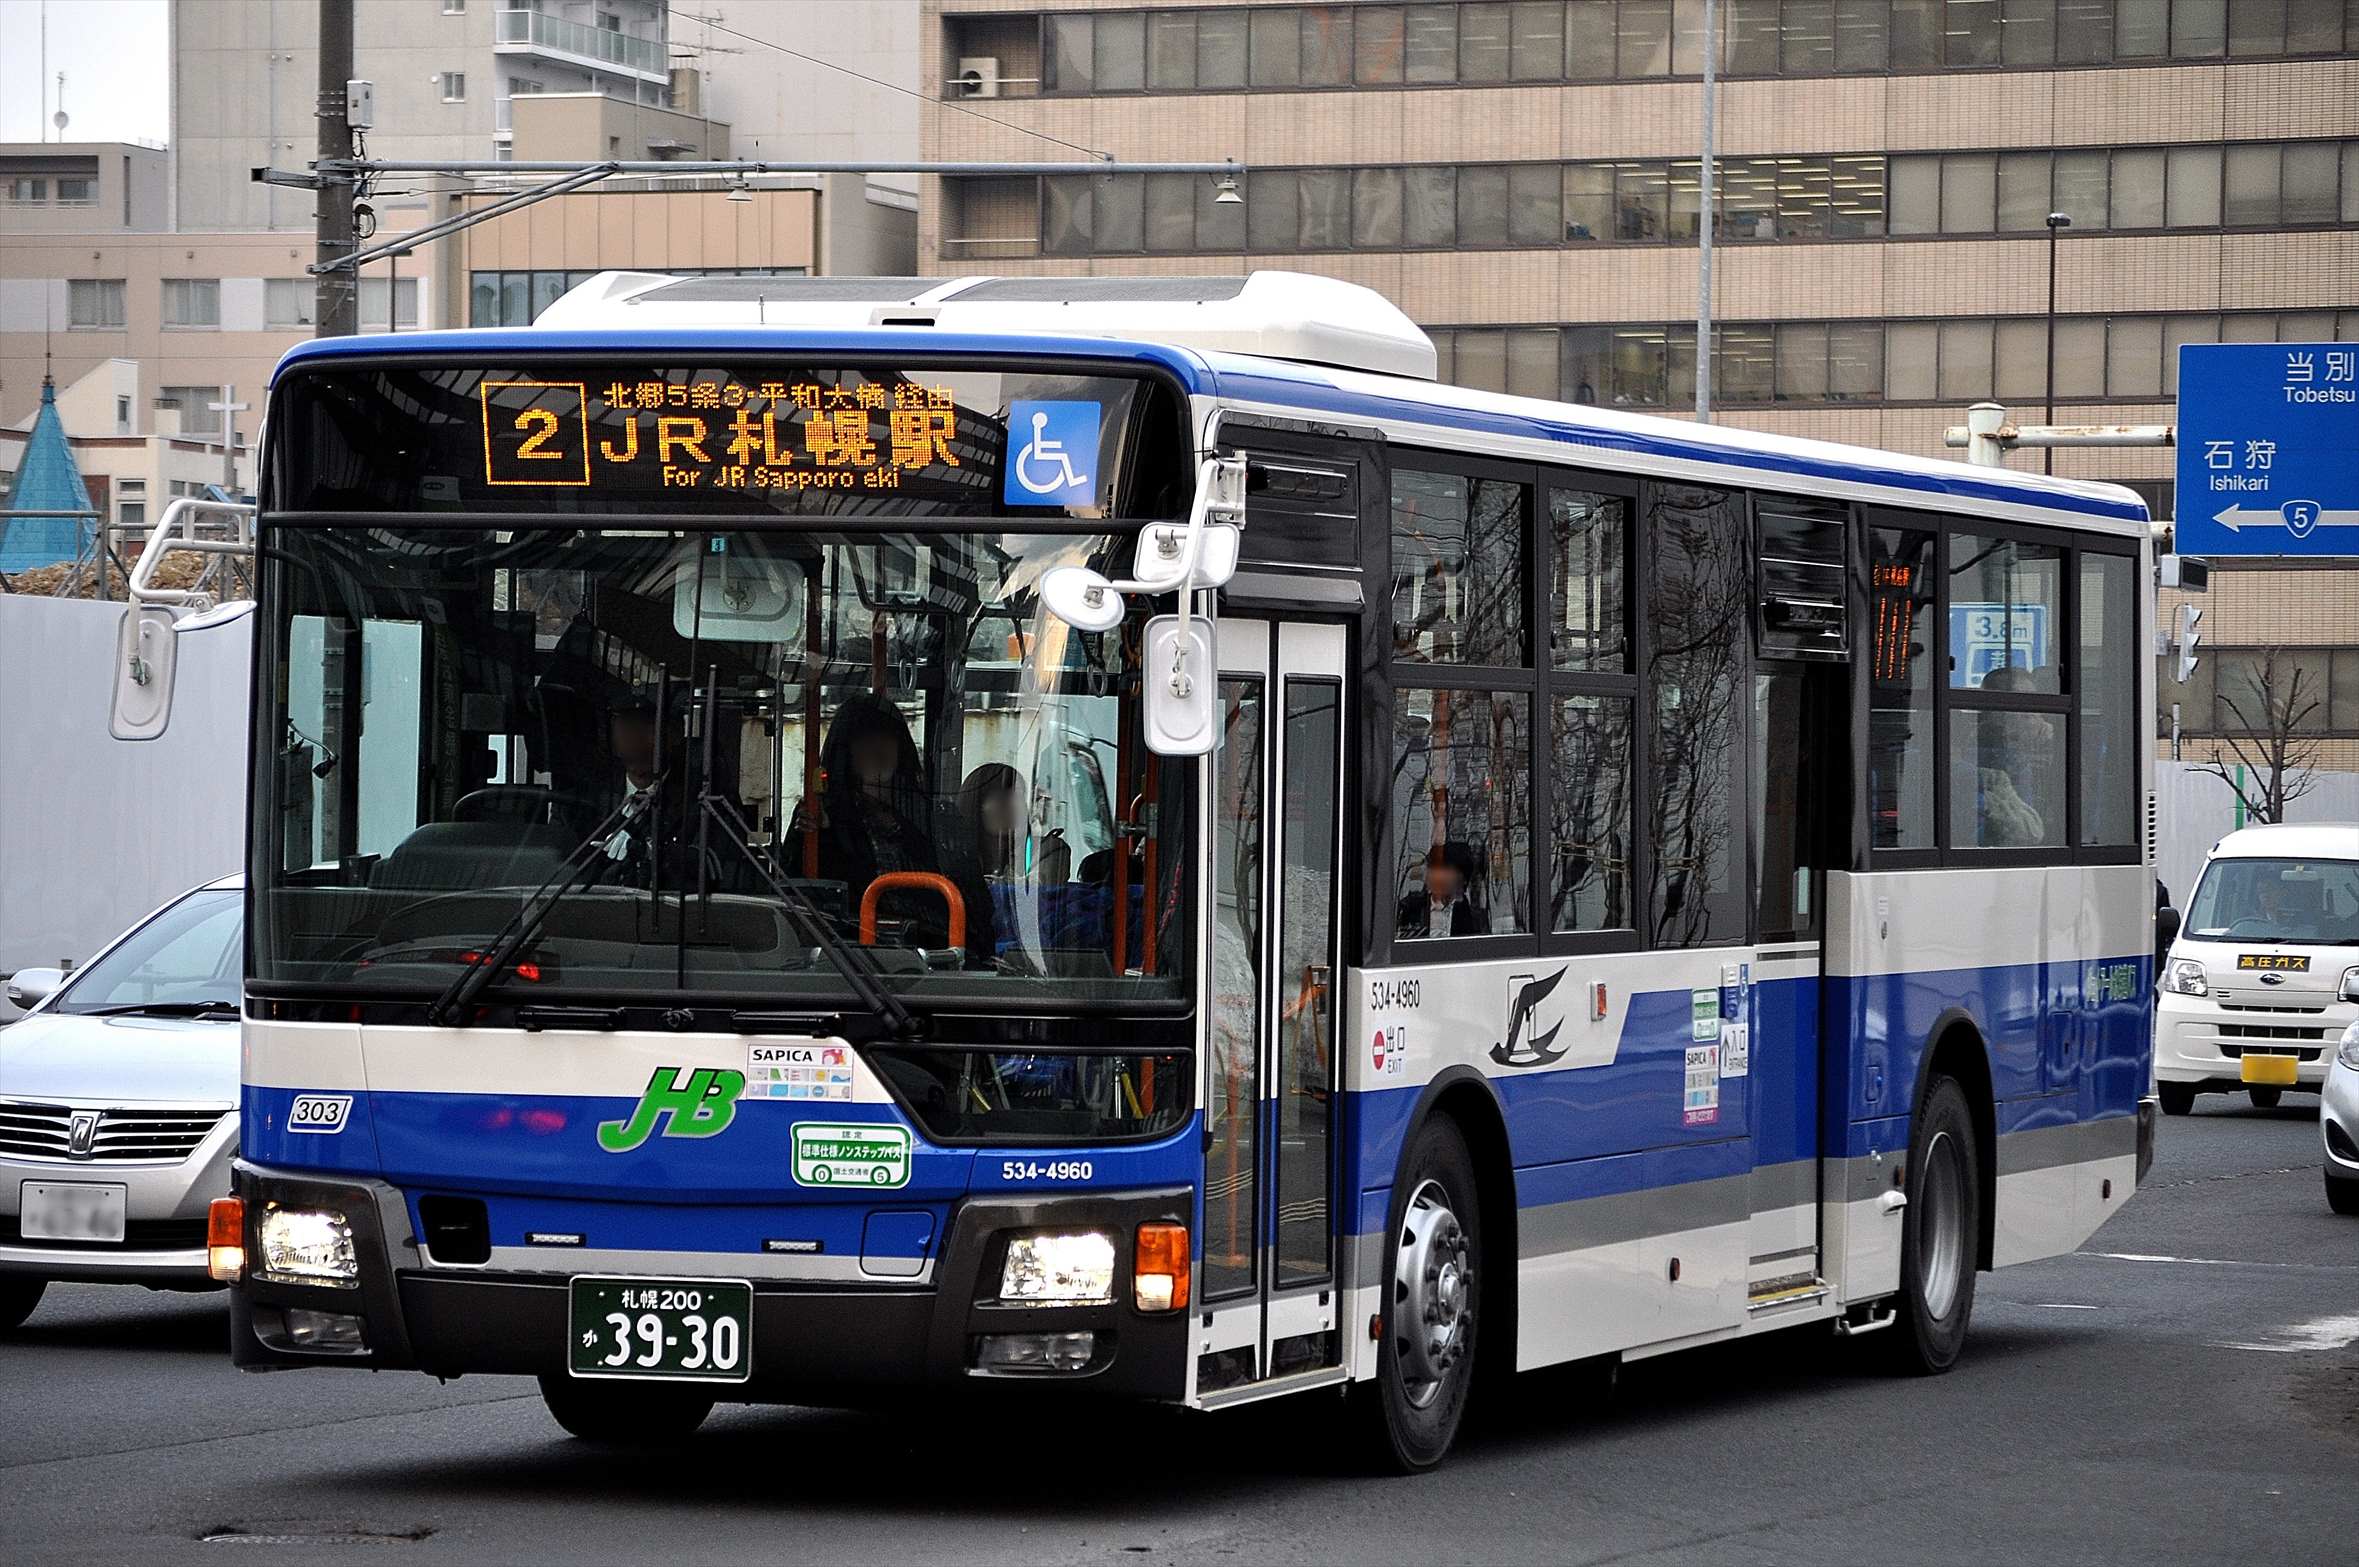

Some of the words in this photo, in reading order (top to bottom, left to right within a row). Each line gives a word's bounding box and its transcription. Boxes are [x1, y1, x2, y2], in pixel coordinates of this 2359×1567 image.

[2286, 351, 2355, 382] 当別
[2283, 386, 2356, 403] Tobetsu
[514, 408, 563, 460] 2
[600, 410, 960, 469] JR札幌駅
[2204, 440, 2276, 470] 石狩
[663, 466, 701, 488] For
[713, 466, 746, 488] JR
[754, 466, 855, 490] Sapporo
[863, 466, 899, 489] eki
[2209, 475, 2269, 491] Ishikari
[2293, 507, 2309, 529] 5
[2240, 956, 2305, 969] 高圧ガス
[1371, 979, 1420, 1011] 534-4960
[1386, 1026, 1405, 1053] 出口
[752, 1049, 813, 1062] SAPICA
[1387, 1057, 1402, 1074] EXIT
[296, 1101, 339, 1122] 303
[1002, 1162, 1093, 1180] 534-4960
[621, 1289, 702, 1311] 札幌200
[582, 1329, 598, 1348] か
[604, 1312, 739, 1370] 39-30
